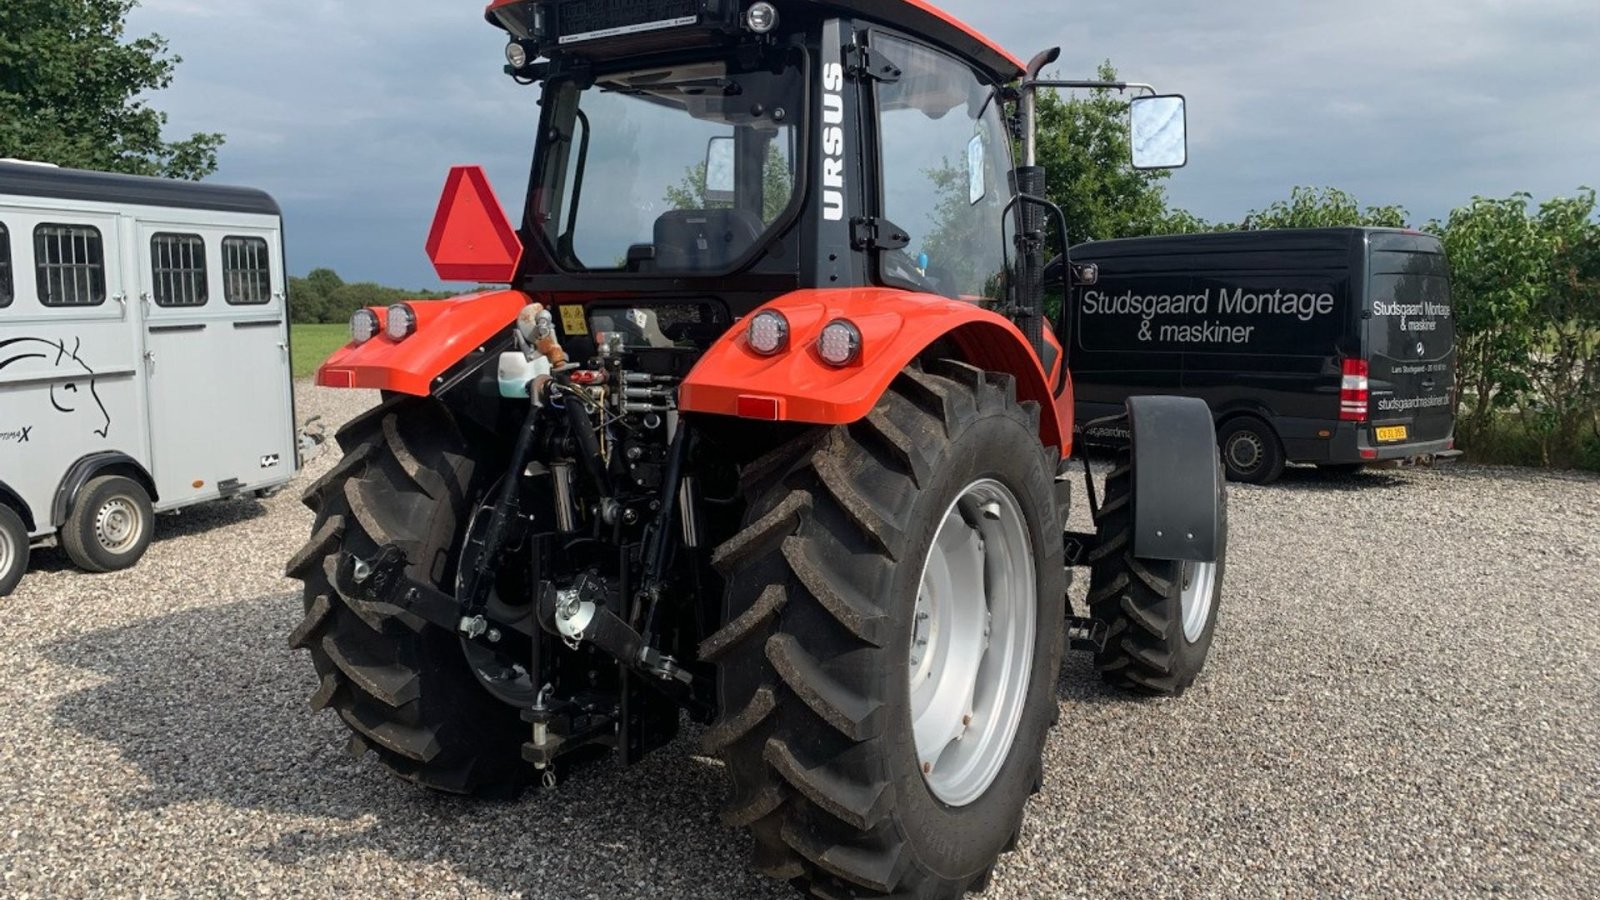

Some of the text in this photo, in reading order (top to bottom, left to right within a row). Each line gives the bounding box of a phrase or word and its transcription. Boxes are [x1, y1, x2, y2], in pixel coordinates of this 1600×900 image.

[823, 62, 844, 220] URSUS
[1082, 287, 1334, 321] Studsgaard Montage
[1373, 301, 1451, 319] Studsgaard Montage
[1137, 319, 1255, 344] & maskiner
[1400, 319, 1437, 331] & maskiner
